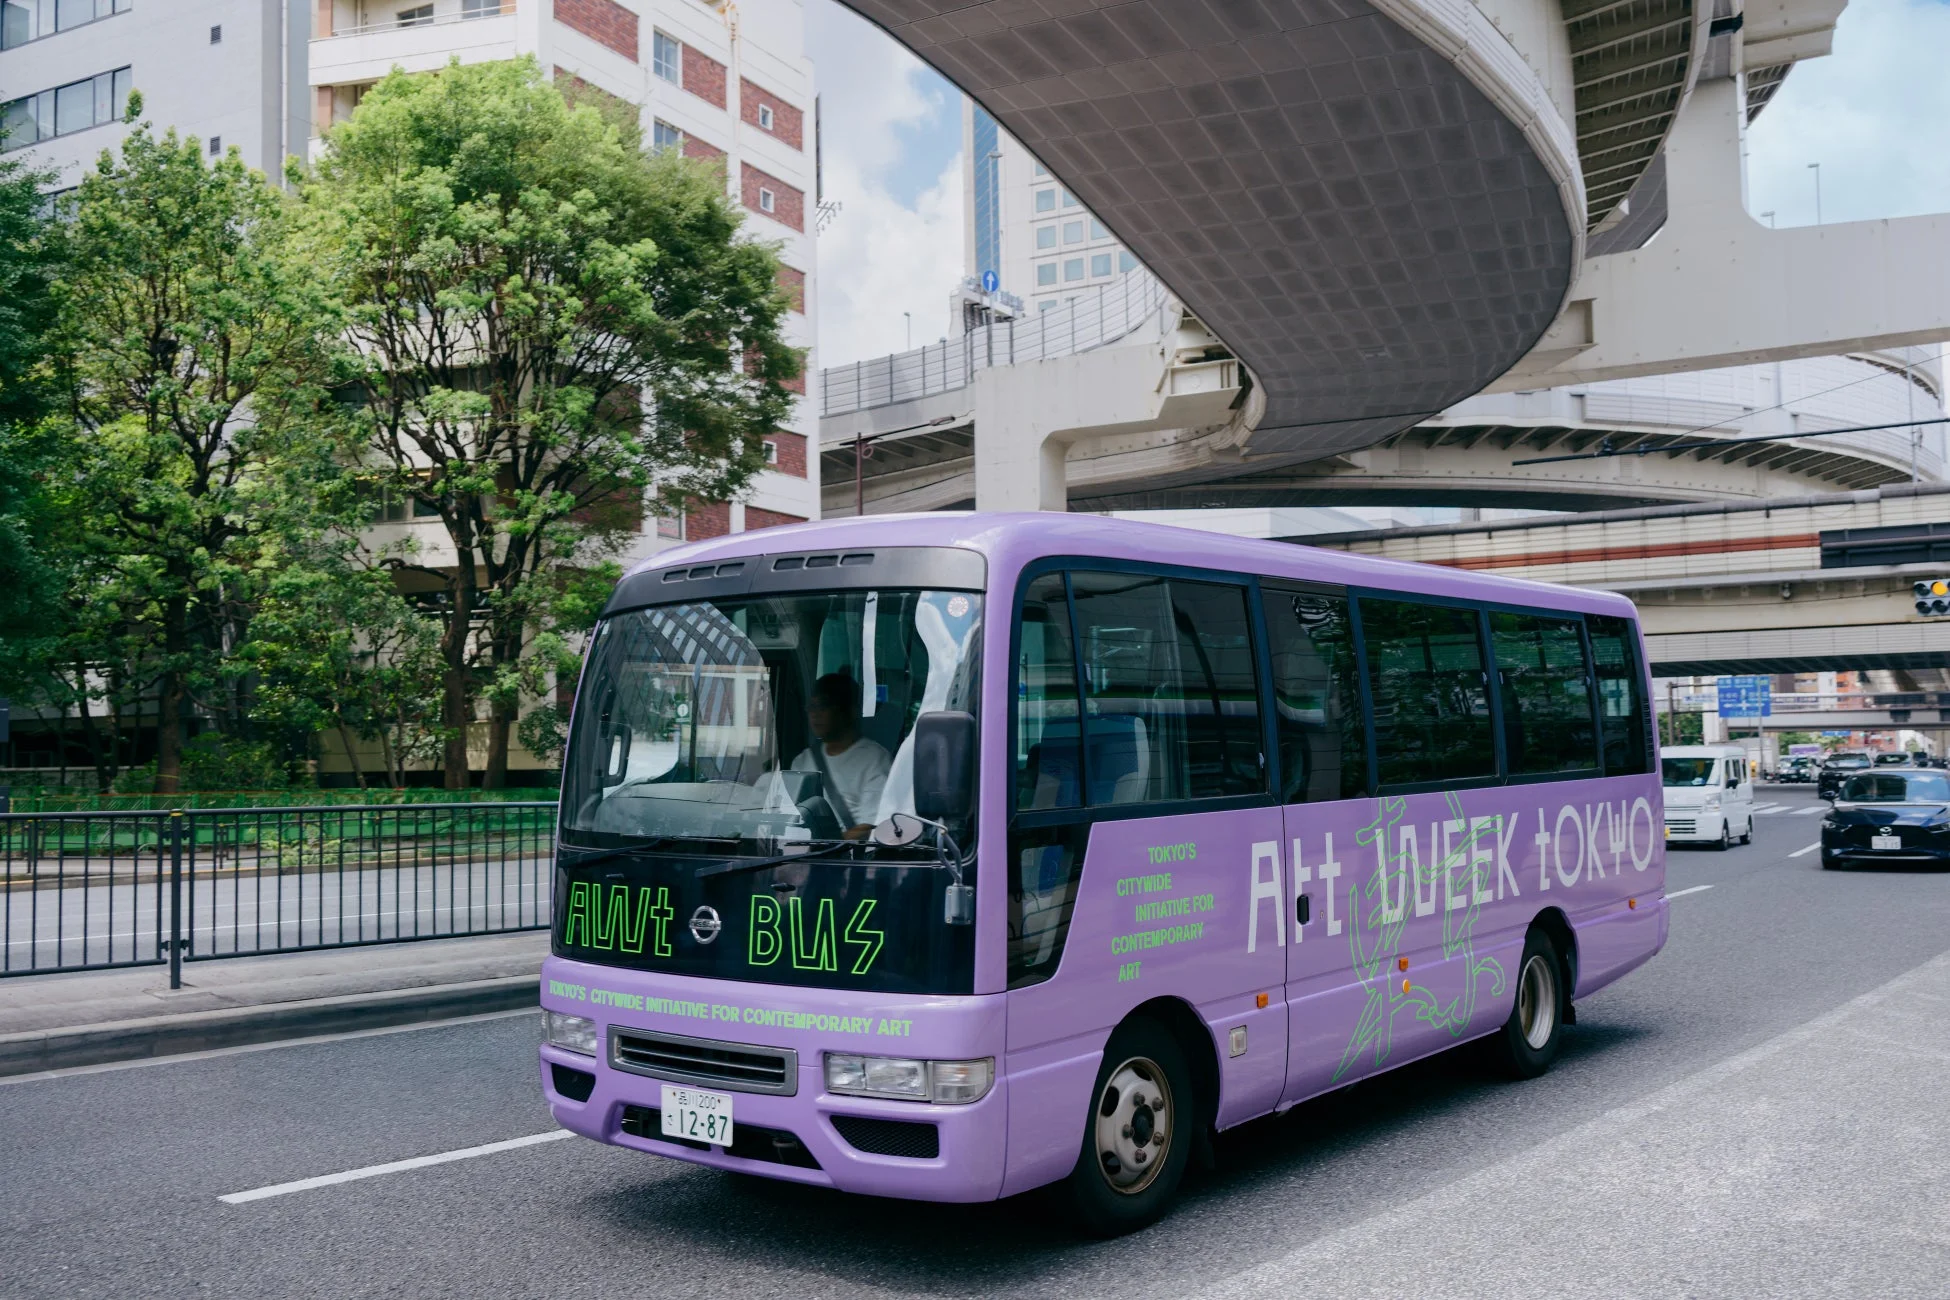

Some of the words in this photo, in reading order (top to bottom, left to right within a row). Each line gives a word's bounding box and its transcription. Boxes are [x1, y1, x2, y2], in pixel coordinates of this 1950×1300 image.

[1148, 842, 1197, 865] TOKYO'S
[1375, 812, 1520, 924] WEEK
[1116, 872, 1173, 897] CITYWIDE
[1135, 897, 1191, 923] INITIATIVE
[1193, 893, 1215, 913] FOR
[748, 894, 885, 975] BUS
[1111, 921, 1205, 956] CONTEMPORARY
[1118, 961, 1142, 983] ART
[549, 979, 586, 1001] TOKYO'S
[590, 988, 644, 1012] CITYWIDE
[646, 996, 708, 1020] INITIATIVE
[711, 1004, 740, 1023] FOR
[743, 1007, 873, 1035] CONTEMPORARY
[876, 1018, 913, 1037] ART
[699, 1094, 716, 1110] 200
